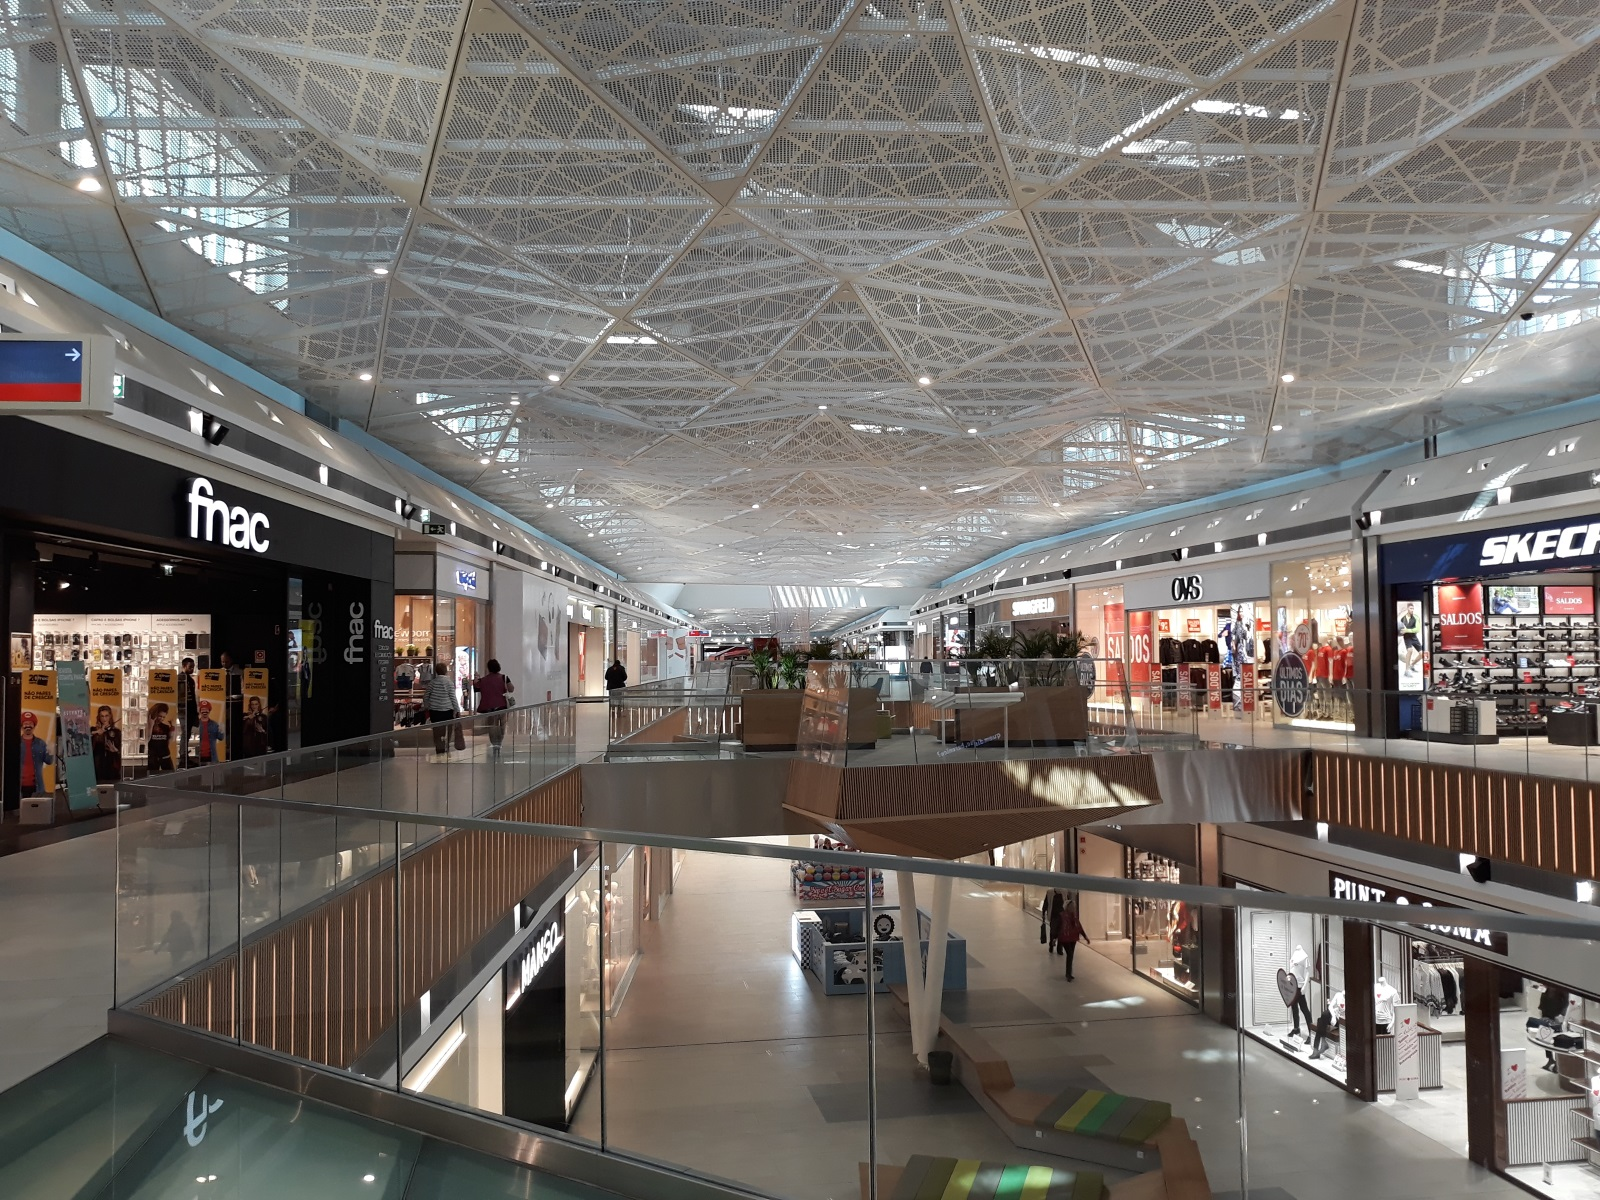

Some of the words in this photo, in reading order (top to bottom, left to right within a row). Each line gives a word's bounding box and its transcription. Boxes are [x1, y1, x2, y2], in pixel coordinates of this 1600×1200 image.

[189, 477, 270, 553] fnac
[1171, 574, 1203, 602] OVS
[344, 602, 364, 664] fnac
[374, 619, 394, 640] fnac
[1440, 612, 1482, 626] SALDOS
[1210, 671, 1220, 701] SADOS
[1334, 877, 1386, 903] PUNT
[521, 921, 559, 994] MANGO
